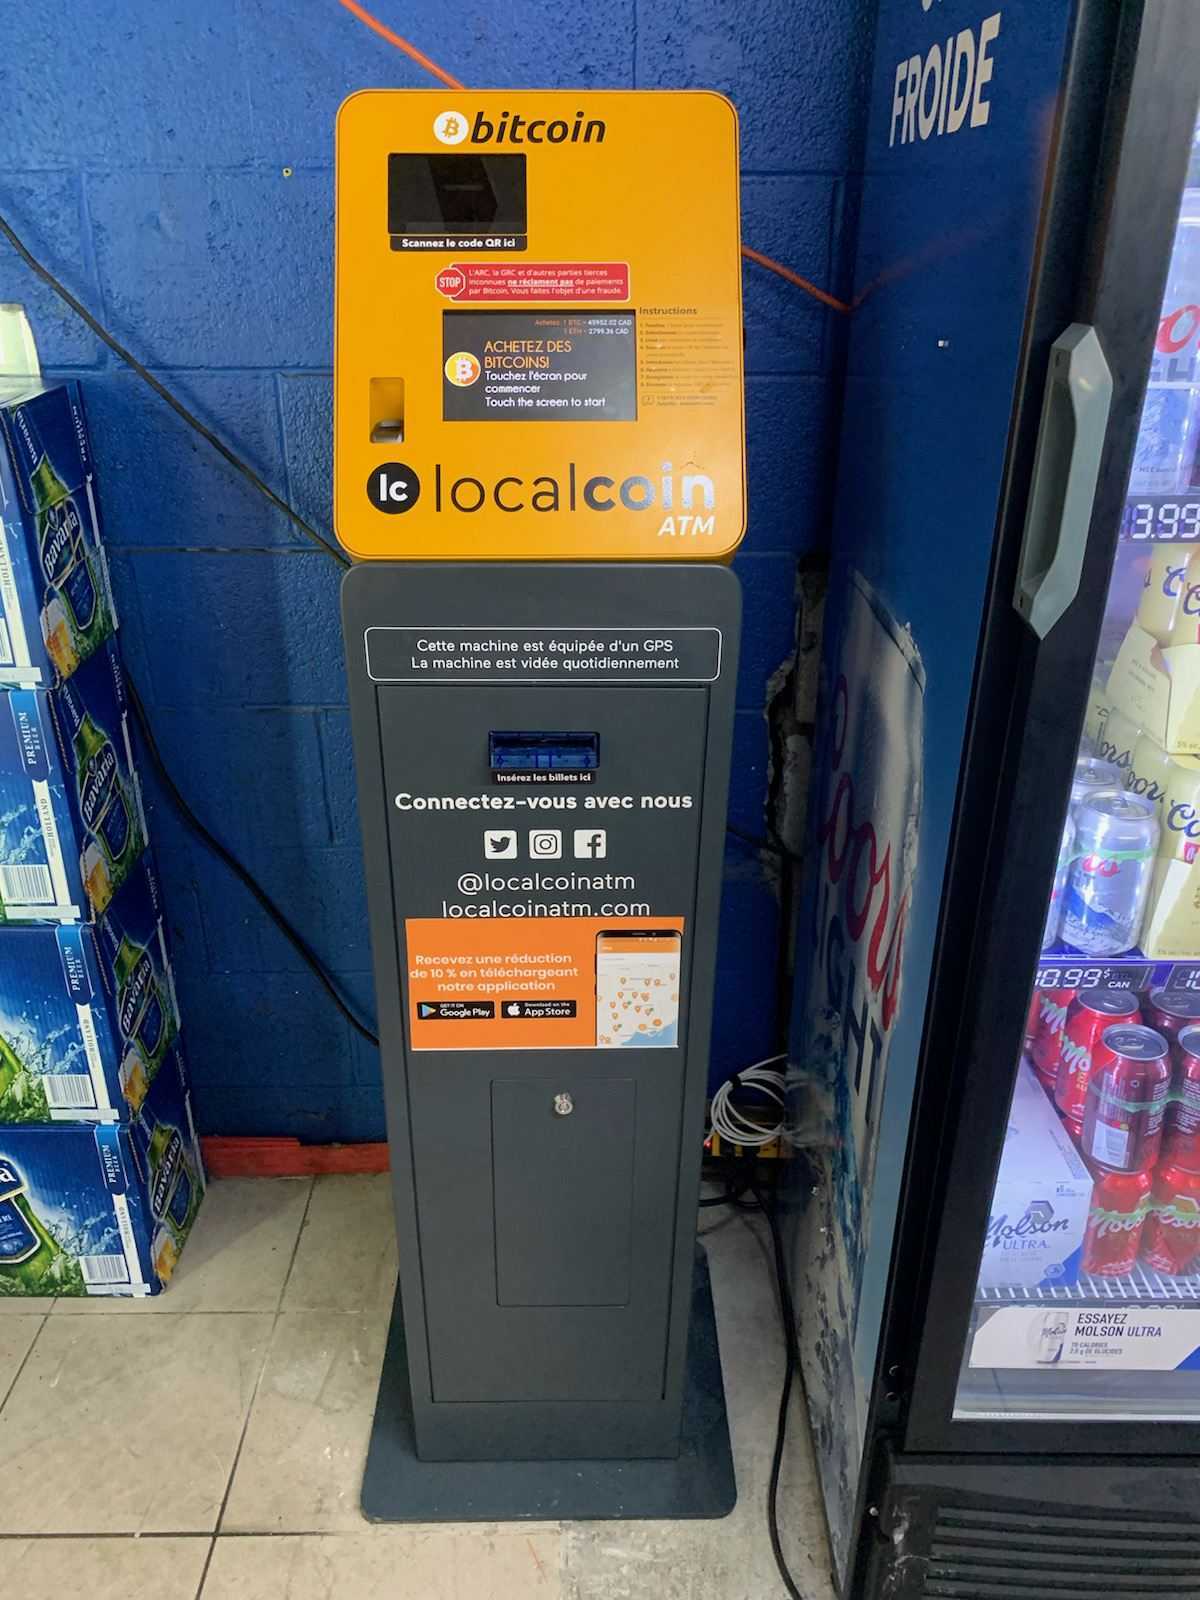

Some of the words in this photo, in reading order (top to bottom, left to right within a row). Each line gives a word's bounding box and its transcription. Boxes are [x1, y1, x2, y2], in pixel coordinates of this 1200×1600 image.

[889, 12, 1001, 147] FROIDE
[470, 111, 606, 144] bitcoin
[402, 238, 444, 248] Scannez
[446, 238, 456, 248] le
[458, 238, 483, 248] code
[485, 238, 502, 249] QR
[503, 238, 516, 248] ici
[439, 277, 461, 289] STOP
[639, 306, 697, 315] Instructions
[484, 340, 544, 353] ACHETEZ
[547, 340, 572, 353] DES
[484, 356, 550, 369] BITCOINS!
[485, 370, 527, 381] Touchez
[529, 370, 562, 381] l'écran
[564, 373, 588, 383] pour
[485, 385, 541, 393] commencer
[485, 397, 516, 407] Touch
[517, 397, 534, 407] the
[536, 399, 569, 407] screen
[571, 397, 582, 407] to
[583, 397, 606, 407] start
[379, 473, 408, 502] lc
[435, 460, 715, 512] localcoin
[657, 515, 716, 536] ATM
[416, 639, 456, 652] Cette
[459, 639, 520, 652] machine
[523, 641, 544, 652] est
[548, 640, 604, 655] équipée
[608, 640, 639, 652] d'un
[643, 640, 673, 652] GPS
[411, 657, 429, 669] La
[432, 657, 492, 669] machine
[495, 658, 517, 669] est
[520, 656, 558, 669] vidée
[562, 656, 680, 672] quotidiennement
[18, 712, 37, 765] PREMIUM
[497, 773, 531, 782] Insérez
[533, 773, 547, 782] les
[548, 773, 578, 782] billets
[579, 773, 591, 782] ici
[83, 750, 115, 823] Bavaria
[395, 793, 577, 810] Connectez-vous
[584, 795, 634, 809] avec
[641, 794, 693, 809] nous
[457, 872, 636, 896] @localcoinatm
[442, 900, 651, 918] localcoinatm.com
[415, 954, 473, 965] Recevez
[475, 956, 502, 965] une
[504, 953, 572, 965] réduction
[64, 945, 81, 992] PREMIUM
[409, 968, 427, 978] de
[430, 968, 444, 978] 10
[445, 968, 457, 978] %
[459, 970, 477, 978] en
[480, 967, 579, 981] téléchargeant
[437, 982, 475, 992] notre
[478, 980, 556, 994] application
[1108, 981, 1130, 989] CAN
[122, 960, 151, 1036] Bavaria
[440, 1008, 472, 1018] Google
[473, 1008, 491, 1018] Play
[524, 1008, 544, 1016] App
[545, 1007, 571, 1015] Store
[101, 1143, 117, 1185] PREMIUM
[154, 1136, 180, 1217] Bavaria
[1002, 1239, 1047, 1250] ULTRA
[1077, 1313, 1128, 1325] ESSAYEZ
[1074, 1326, 1124, 1337] MOLSON
[1127, 1326, 1162, 1337] ULTRA
